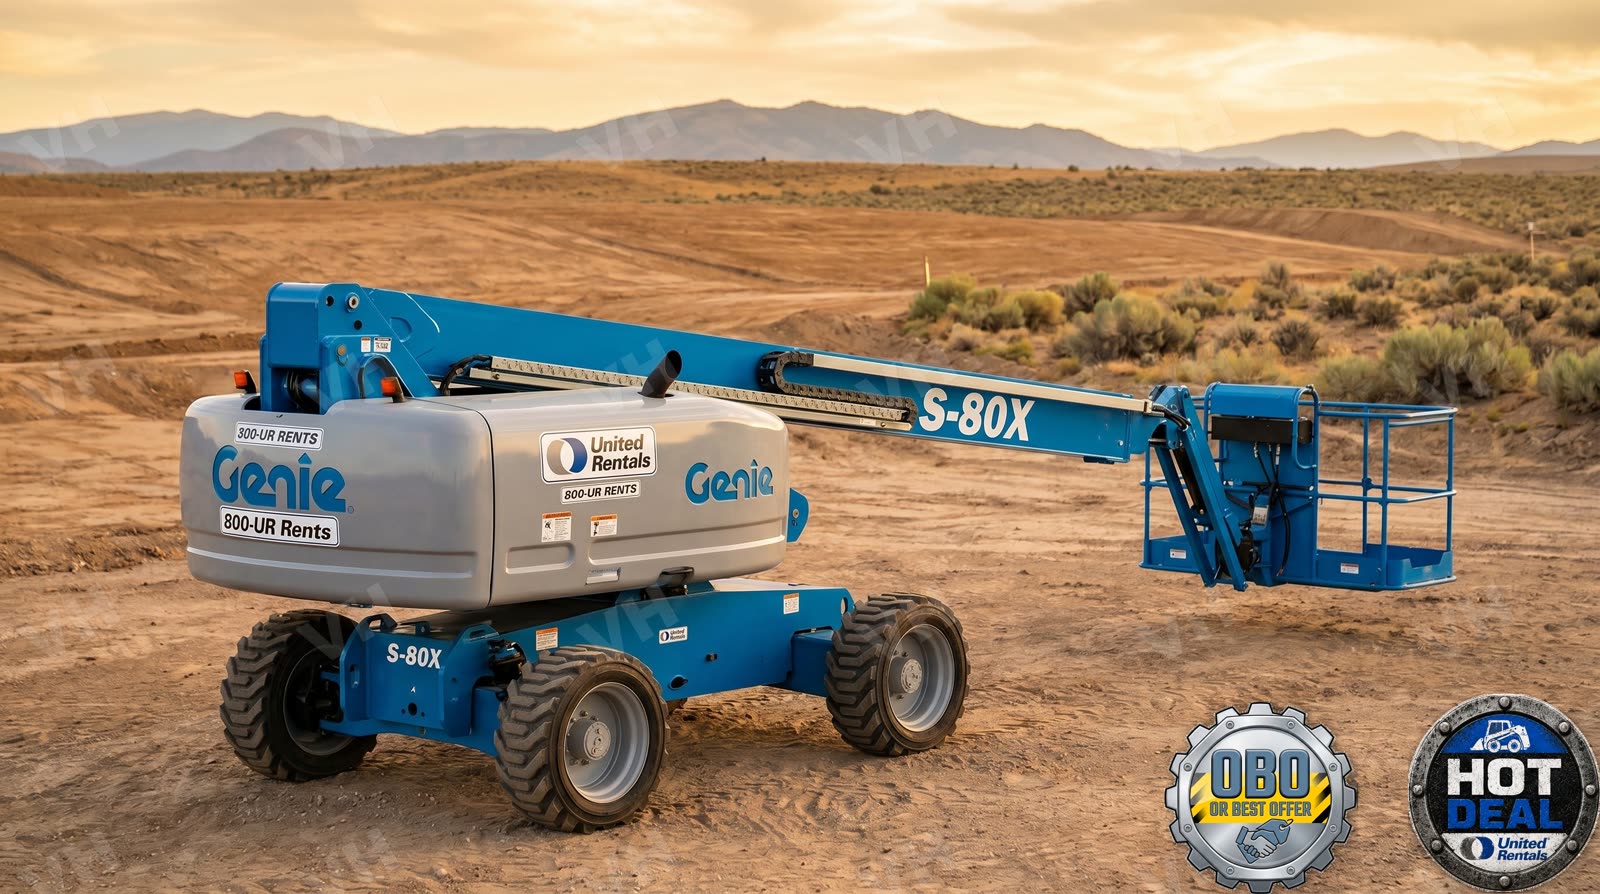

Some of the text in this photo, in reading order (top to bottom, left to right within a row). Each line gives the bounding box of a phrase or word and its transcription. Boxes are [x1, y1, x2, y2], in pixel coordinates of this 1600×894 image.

[919, 387, 1035, 441] S-80X
[237, 427, 319, 445] 300-UR RENTS
[591, 433, 644, 453] United
[591, 452, 651, 472] Rentals
[212, 444, 346, 513] Genie
[564, 484, 637, 500] 800-UR RENTS
[685, 459, 774, 505] Genie
[224, 513, 332, 540] 800-UR Rents
[386, 642, 442, 669] S-80X
